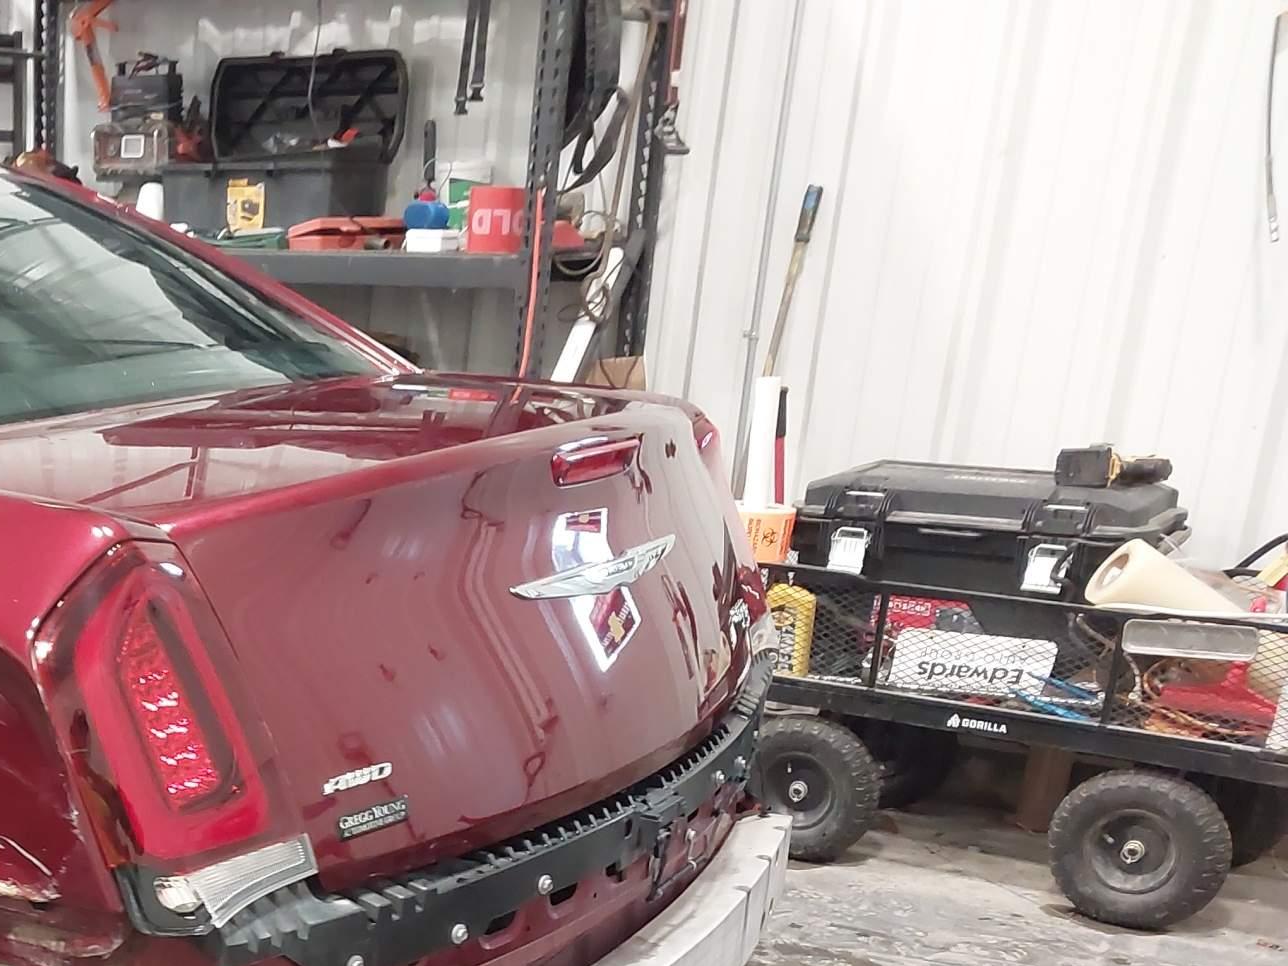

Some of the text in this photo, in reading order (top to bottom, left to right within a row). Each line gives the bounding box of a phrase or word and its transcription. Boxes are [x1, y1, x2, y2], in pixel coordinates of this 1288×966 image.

[917, 661, 1024, 685] Edwards
[961, 718, 1007, 734] GORILLA
[322, 763, 393, 795] AWD
[339, 810, 373, 829] GREGG
[372, 800, 407, 818] YOUNG
